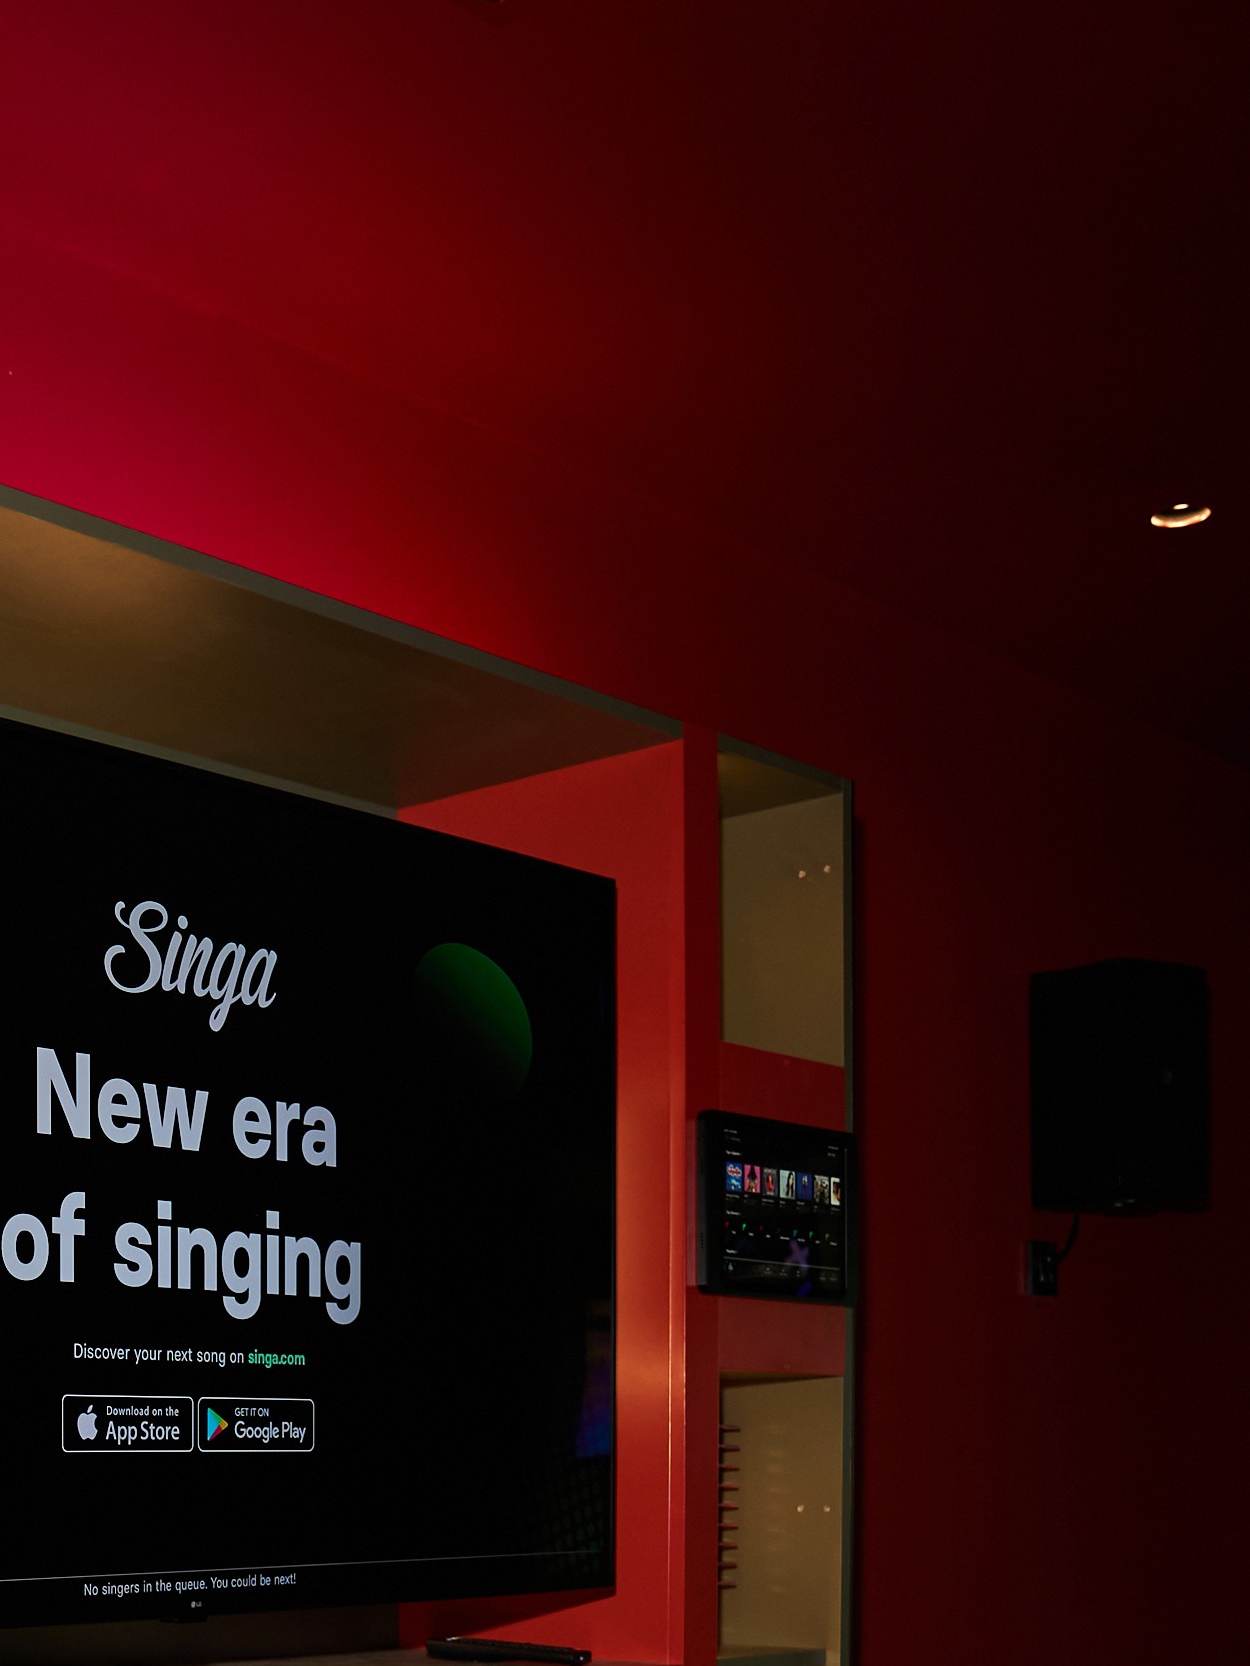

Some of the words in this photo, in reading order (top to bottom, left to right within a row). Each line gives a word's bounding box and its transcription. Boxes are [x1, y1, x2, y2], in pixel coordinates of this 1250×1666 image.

[104, 900, 277, 1032] Singa
[36, 1046, 209, 1152] New
[232, 1096, 337, 1168] era
[1, 1192, 86, 1283] of
[113, 1199, 361, 1325] singing
[73, 1343, 130, 1360] Discover
[134, 1348, 162, 1365] your
[166, 1348, 193, 1362] next
[196, 1350, 226, 1367] song
[229, 1351, 244, 1364] on
[248, 1349, 305, 1368] singa.com
[106, 1406, 149, 1417] Download
[152, 1408, 162, 1416] on
[165, 1406, 179, 1417] the
[234, 1407, 249, 1417] GET
[250, 1407, 257, 1417] IT
[257, 1408, 270, 1417] ON
[106, 1421, 138, 1445] App
[140, 1421, 180, 1441] Store
[234, 1421, 279, 1443] Google
[282, 1422, 306, 1443] Play
[84, 1583, 98, 1596] No
[101, 1581, 140, 1598] singers
[143, 1580, 152, 1593] in
[155, 1579, 172, 1592] the
[175, 1578, 208, 1594] queue.
[210, 1576, 228, 1589] You
[231, 1574, 257, 1588] could
[259, 1574, 271, 1586] be
[274, 1573, 296, 1585] next!
